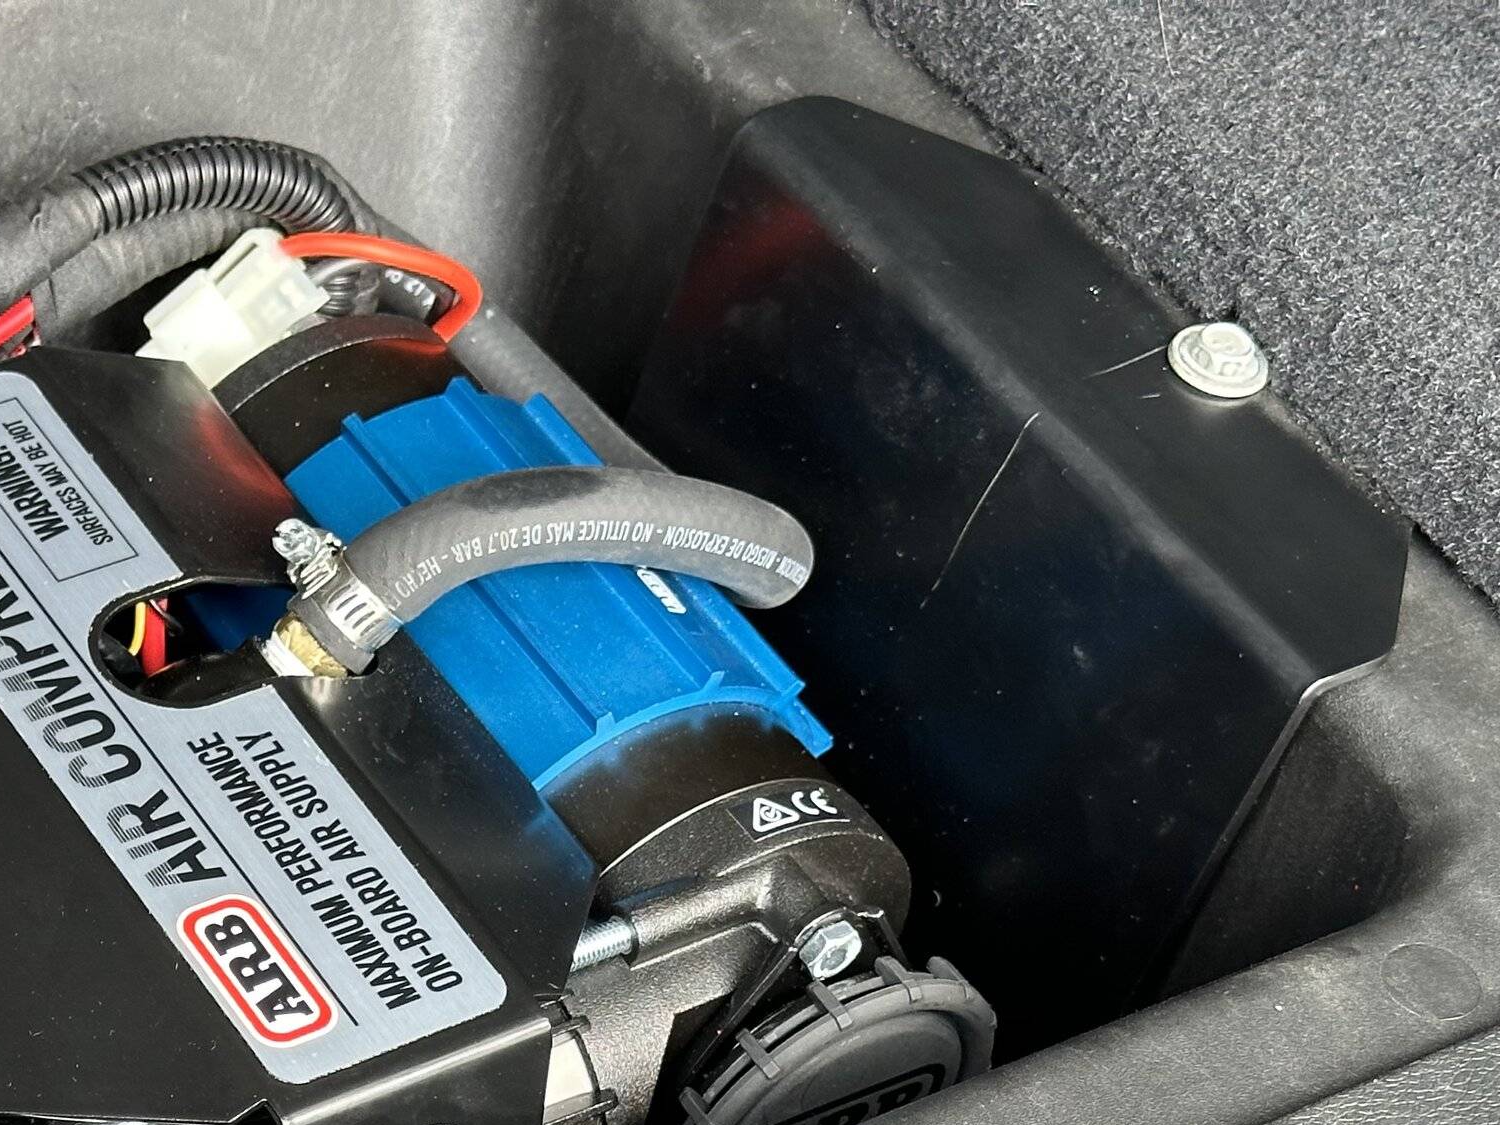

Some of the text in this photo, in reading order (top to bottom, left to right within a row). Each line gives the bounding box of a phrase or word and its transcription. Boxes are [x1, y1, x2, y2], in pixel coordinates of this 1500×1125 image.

[2, 419, 114, 547] SURFACES MAY BE HOT
[487, 528, 519, 554] 20.7
[522, 523, 542, 548] DE
[546, 520, 575, 546] MÁS
[578, 519, 631, 542] UTILICE
[631, 521, 654, 543] NO
[663, 525, 731, 558] EXPLOSIÓN
[451, 536, 483, 564] BAR
[725, 537, 747, 559] DE
[394, 555, 443, 598] HECHO
[106, 789, 228, 888] AIR
[186, 731, 422, 1010] MAXIMUM PERFORMANCE
[235, 731, 463, 993] ON-BOARD AIR SUPPLY
[204, 914, 314, 1023] ARB
